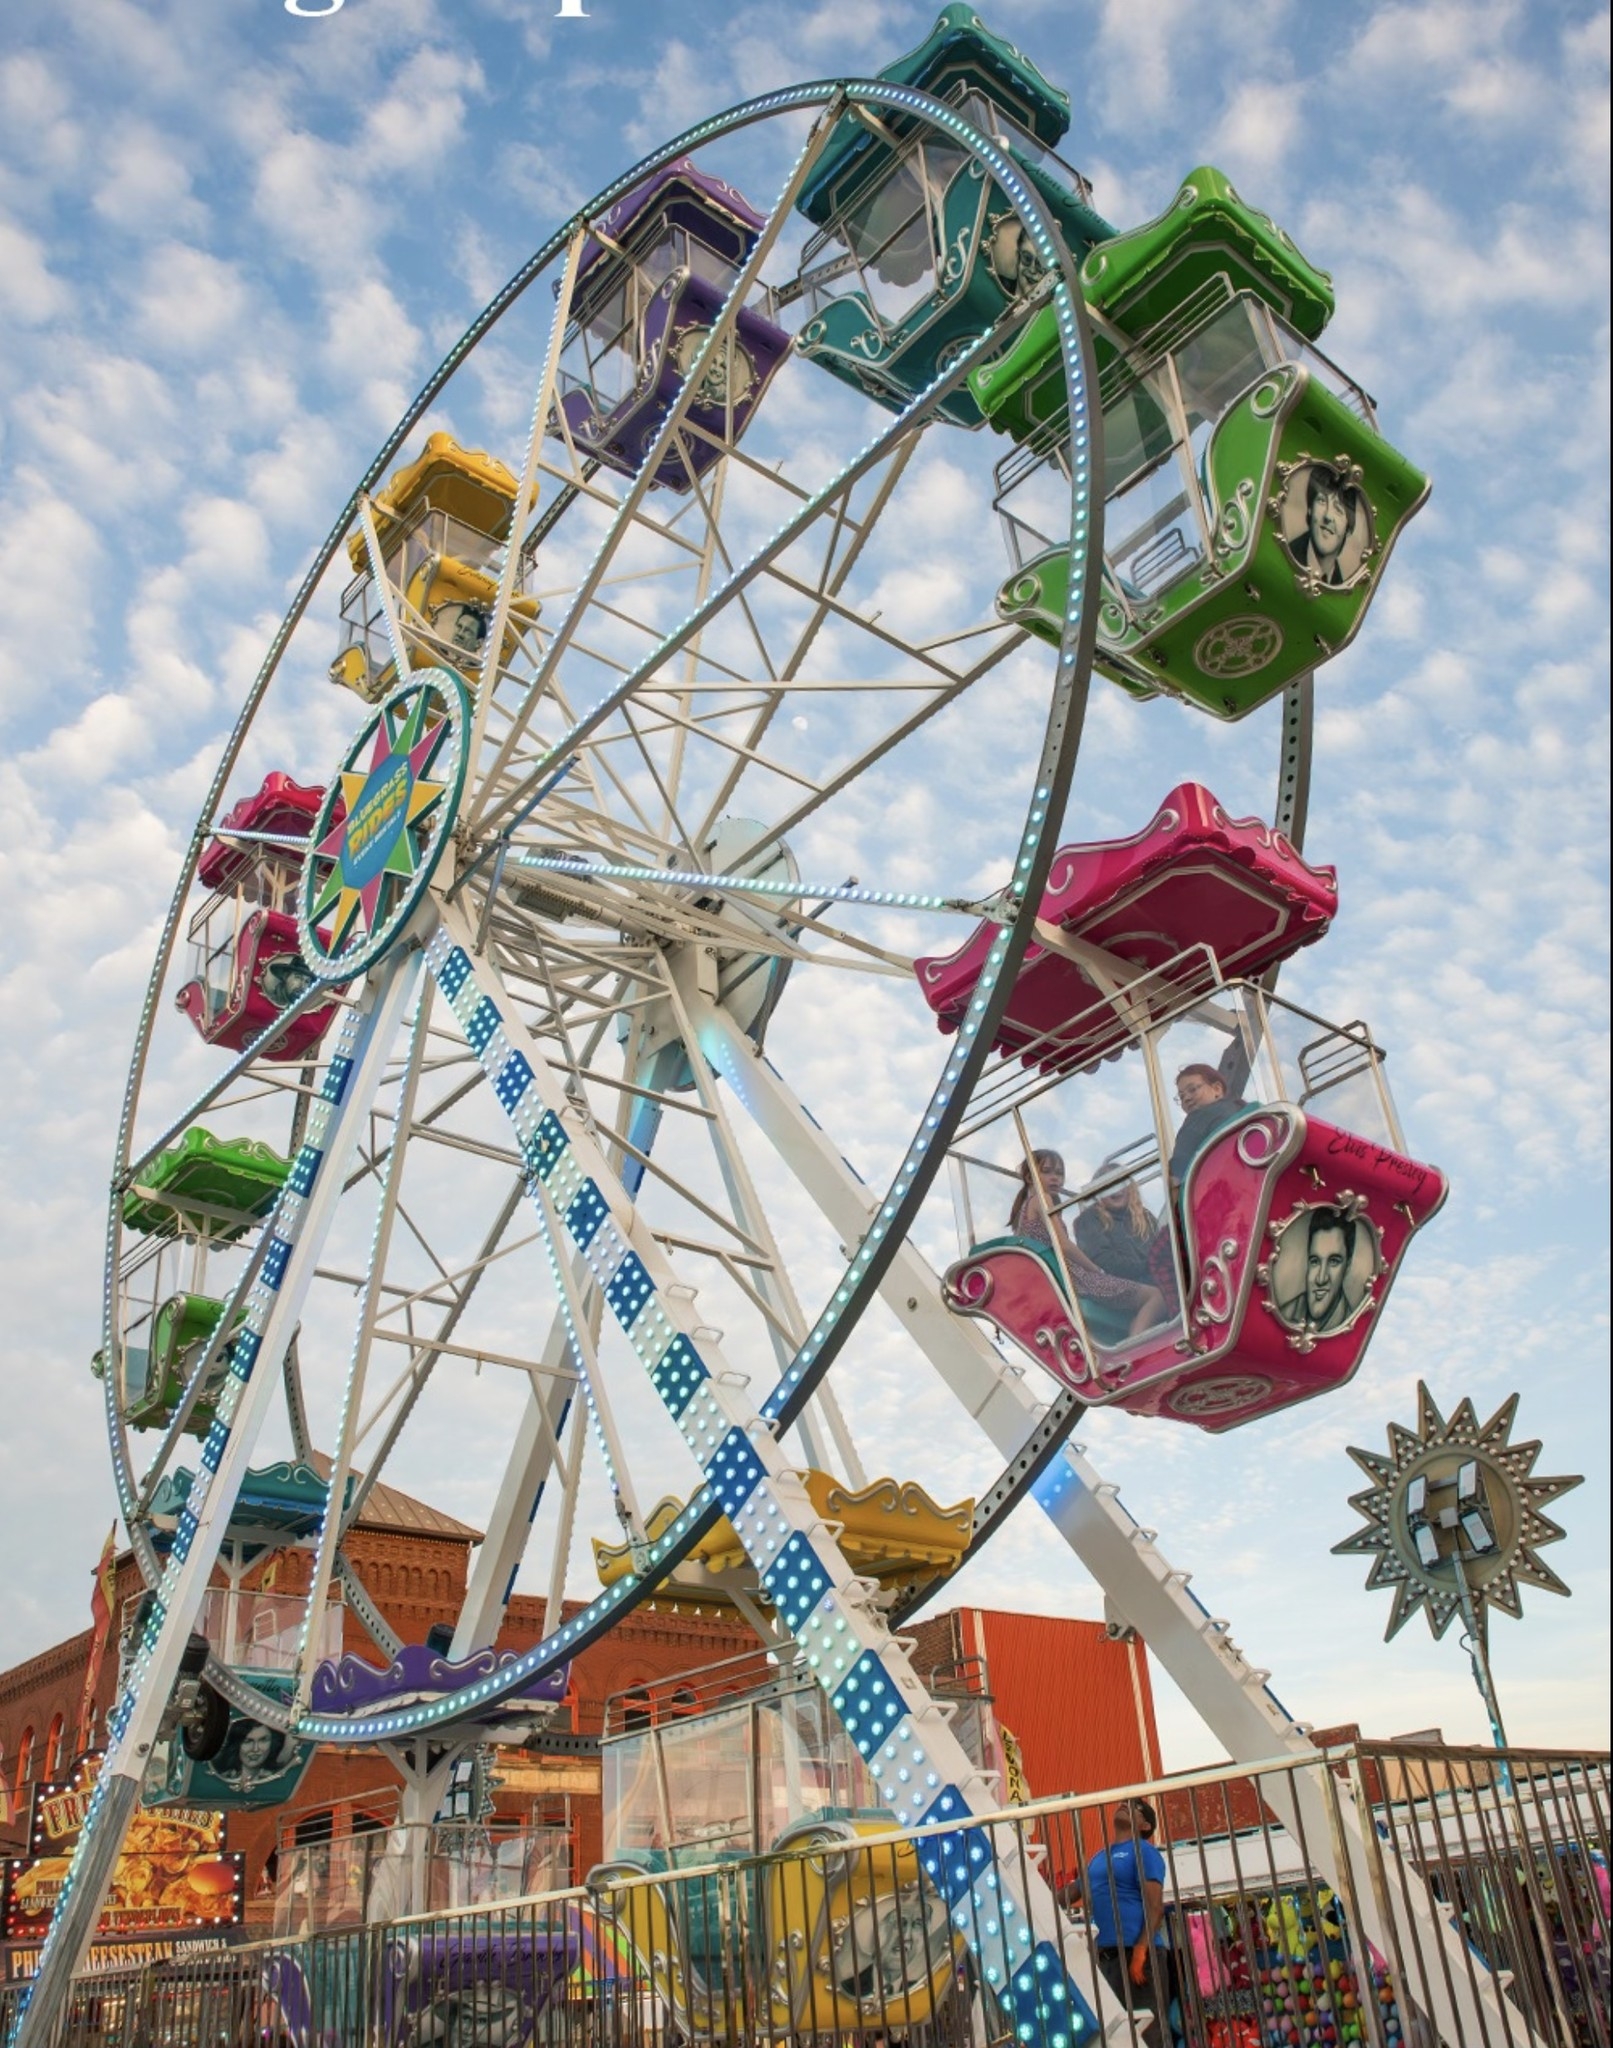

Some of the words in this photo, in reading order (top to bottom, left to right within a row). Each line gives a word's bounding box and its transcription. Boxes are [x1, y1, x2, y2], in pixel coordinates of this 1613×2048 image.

[347, 761, 408, 834] BLUEGRASS
[348, 780, 407, 860] RIDES
[1373, 1146, 1428, 1195] Presley
[83, 1941, 172, 1973] EESESTEAK
